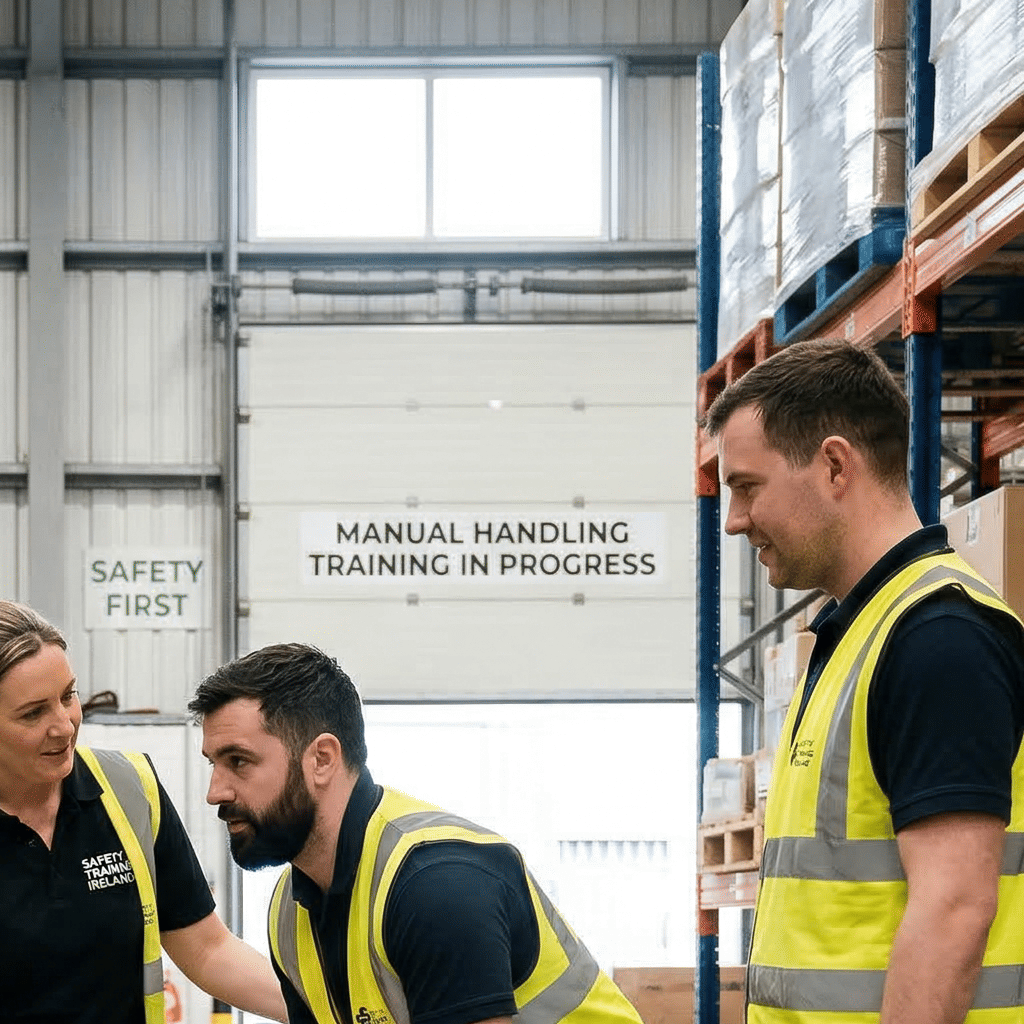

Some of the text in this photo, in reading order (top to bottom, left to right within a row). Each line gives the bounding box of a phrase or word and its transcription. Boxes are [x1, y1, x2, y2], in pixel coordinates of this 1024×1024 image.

[336, 521, 630, 544] MANUAL HANDLING
[91, 560, 204, 583] SAFETY
[308, 553, 657, 577] TRAINING IN PROGRESS
[107, 593, 189, 617] FIRST
